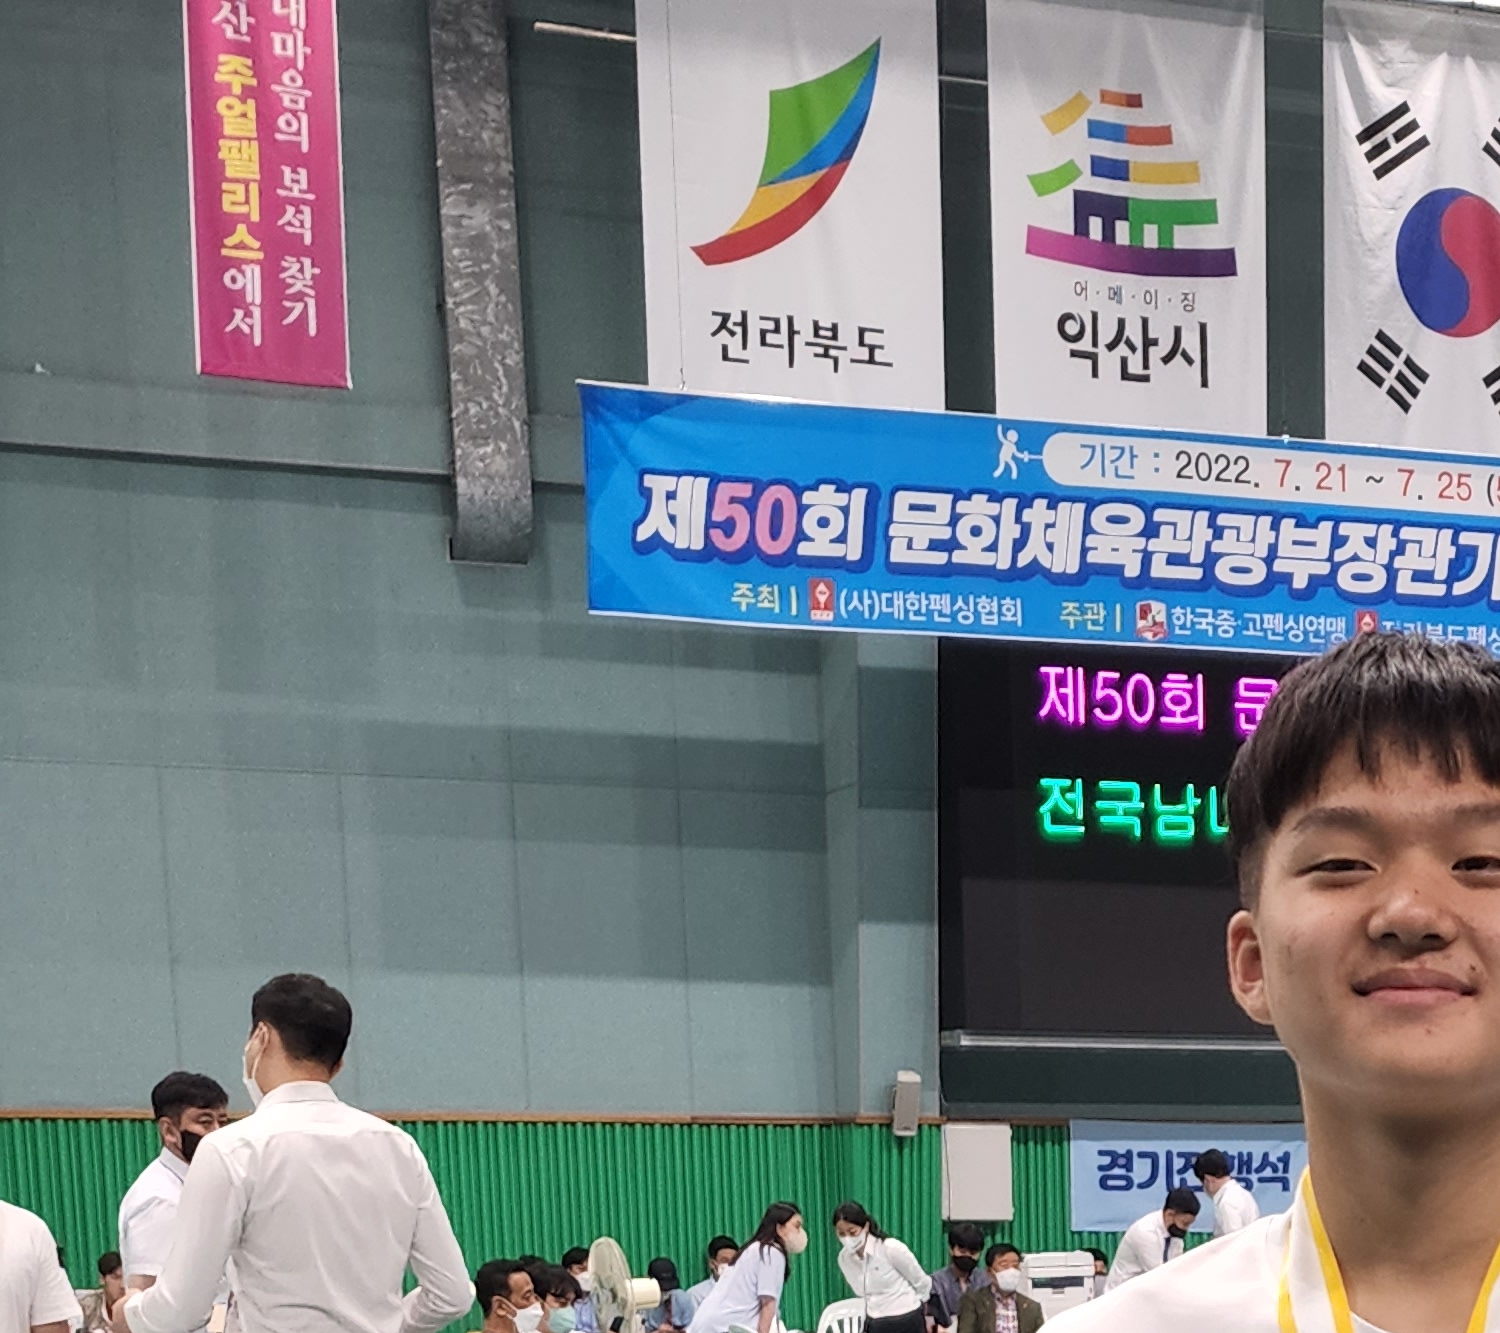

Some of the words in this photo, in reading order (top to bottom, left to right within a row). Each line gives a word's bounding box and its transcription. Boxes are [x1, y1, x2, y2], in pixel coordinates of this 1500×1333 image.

[276, 165, 316, 246] 보석
[279, 255, 321, 337] 찾기
[709, 309, 894, 369] 전라북도
[1057, 310, 1210, 389] 익산시
[1079, 443, 1138, 480] 기간
[1315, 462, 1348, 492] 21
[1437, 471, 1472, 502] 25
[636, 473, 863, 562] 제50회
[731, 582, 780, 613] 주최
[839, 588, 1023, 627] (사)대한펜싱협회
[1060, 602, 1107, 632] 주관
[1038, 666, 1204, 731] 제50회
